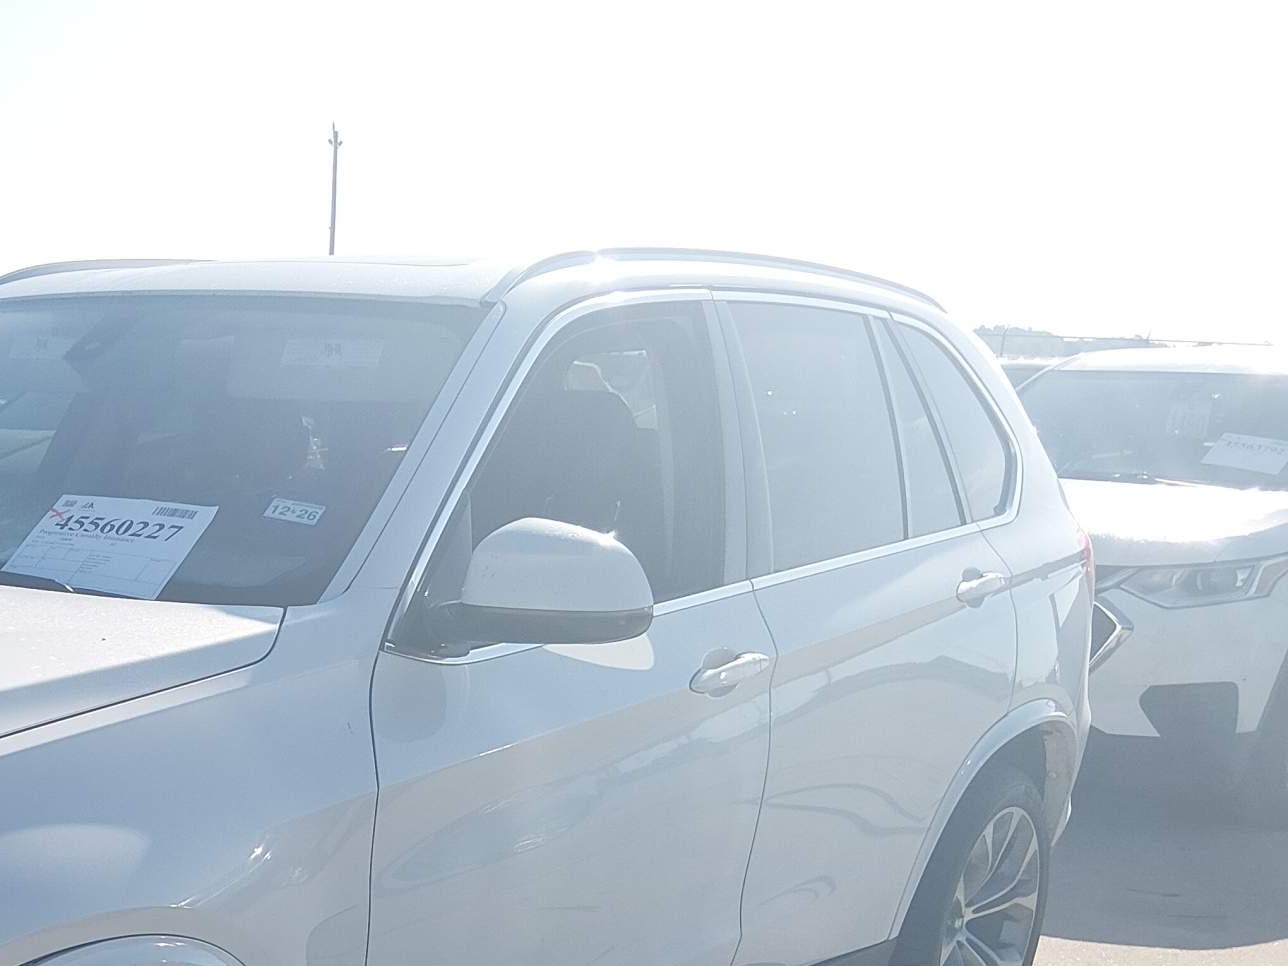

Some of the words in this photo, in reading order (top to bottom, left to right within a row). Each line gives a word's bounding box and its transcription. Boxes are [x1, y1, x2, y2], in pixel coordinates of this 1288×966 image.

[271, 504, 291, 516] 12
[296, 509, 320, 521] 26
[55, 514, 184, 542] 45560227
